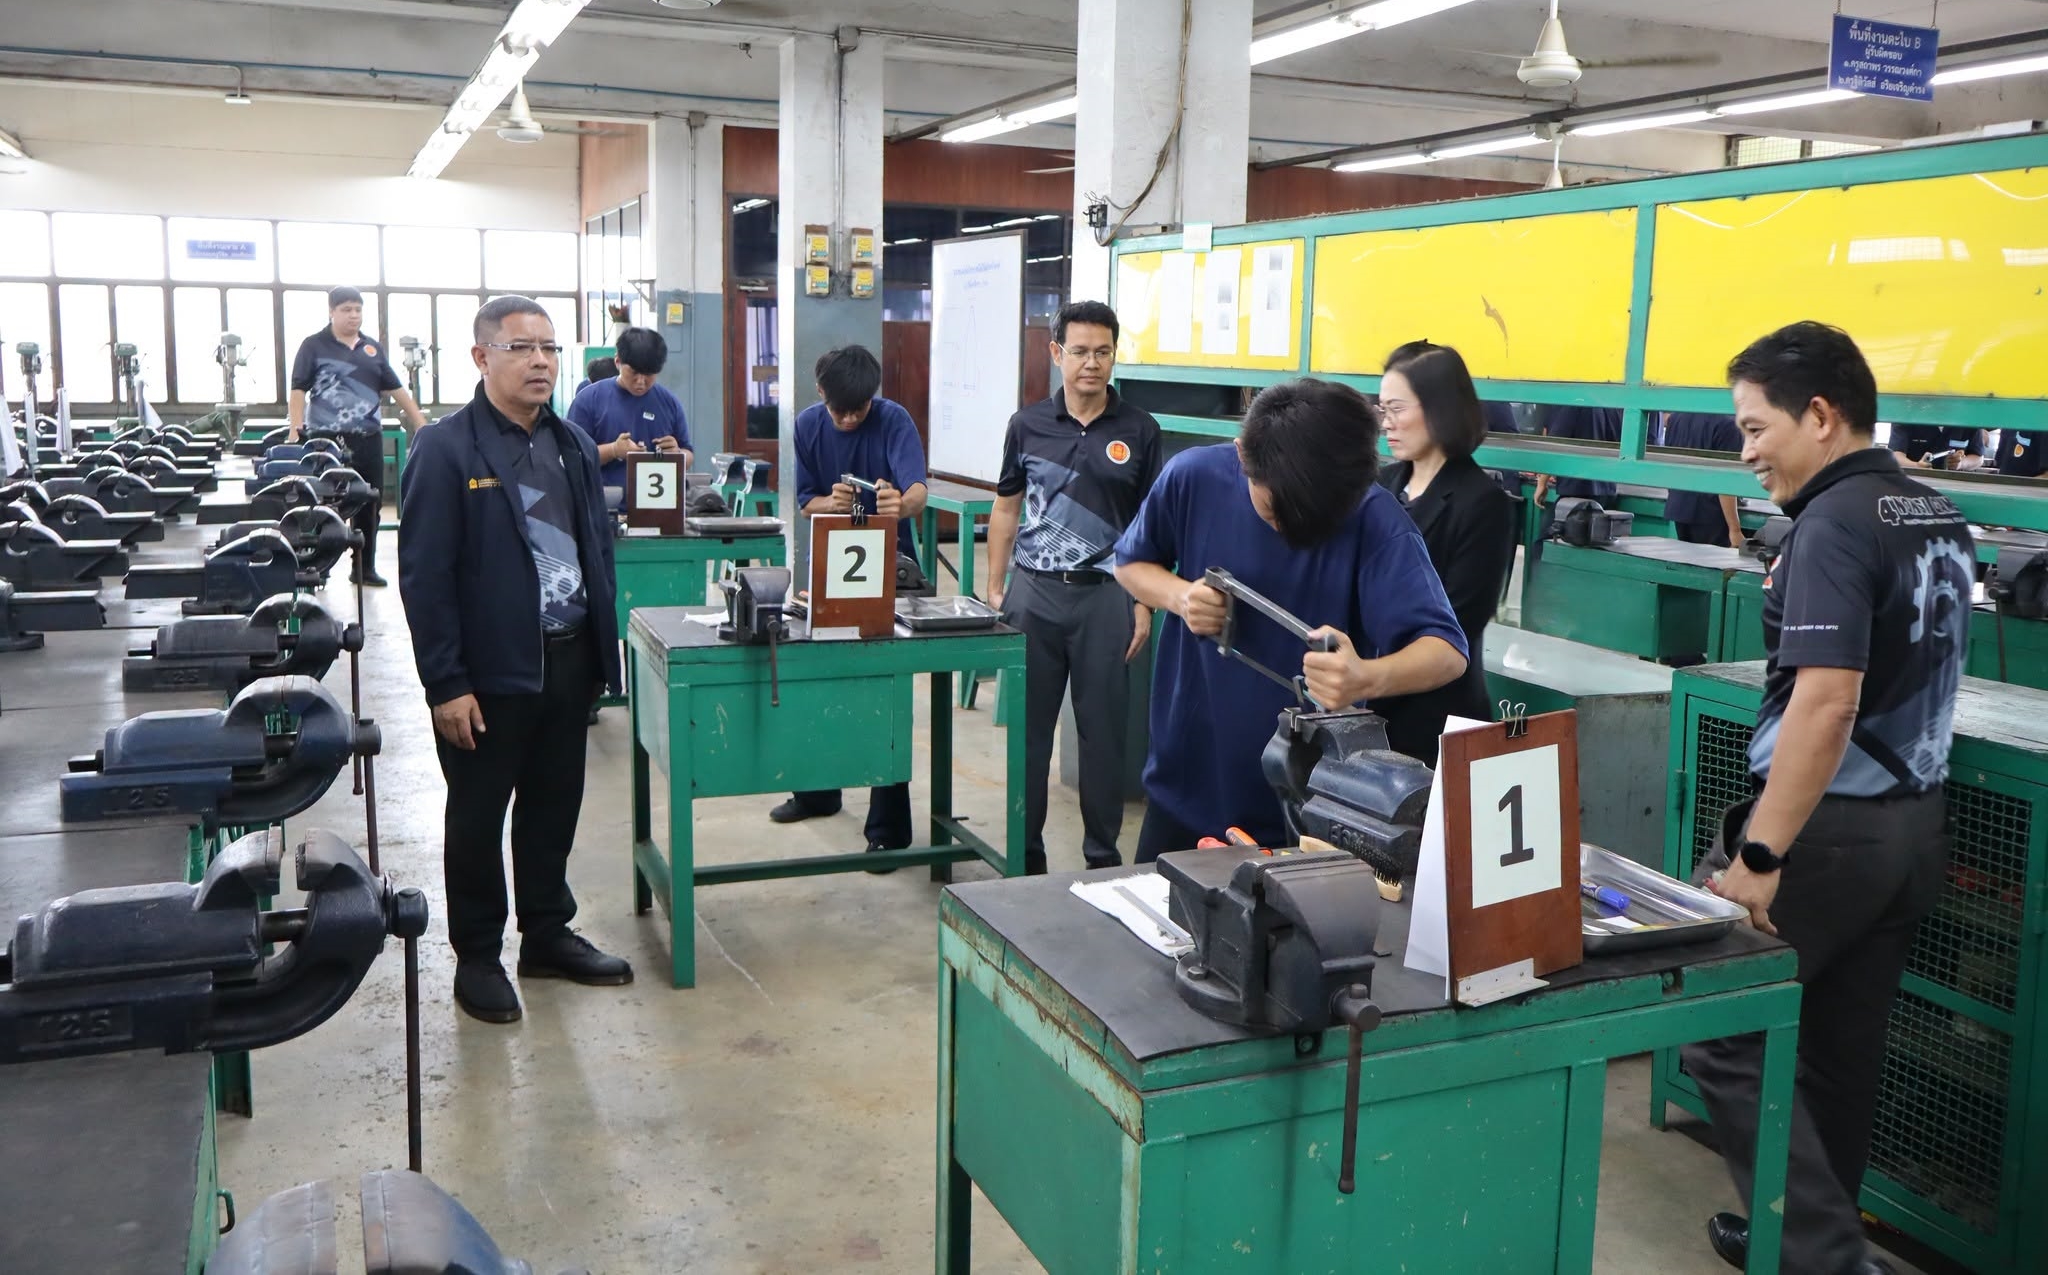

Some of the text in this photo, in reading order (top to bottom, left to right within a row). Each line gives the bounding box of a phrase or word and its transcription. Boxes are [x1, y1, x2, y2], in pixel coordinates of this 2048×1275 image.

[1848, 20, 1922, 49] พื้นที่งานตะไบ B
[1865, 44, 1903, 60] ผู้รับผิดชอบ
[647, 473, 665, 498] 3
[842, 544, 868, 583] 2
[1497, 783, 1535, 868] 1
